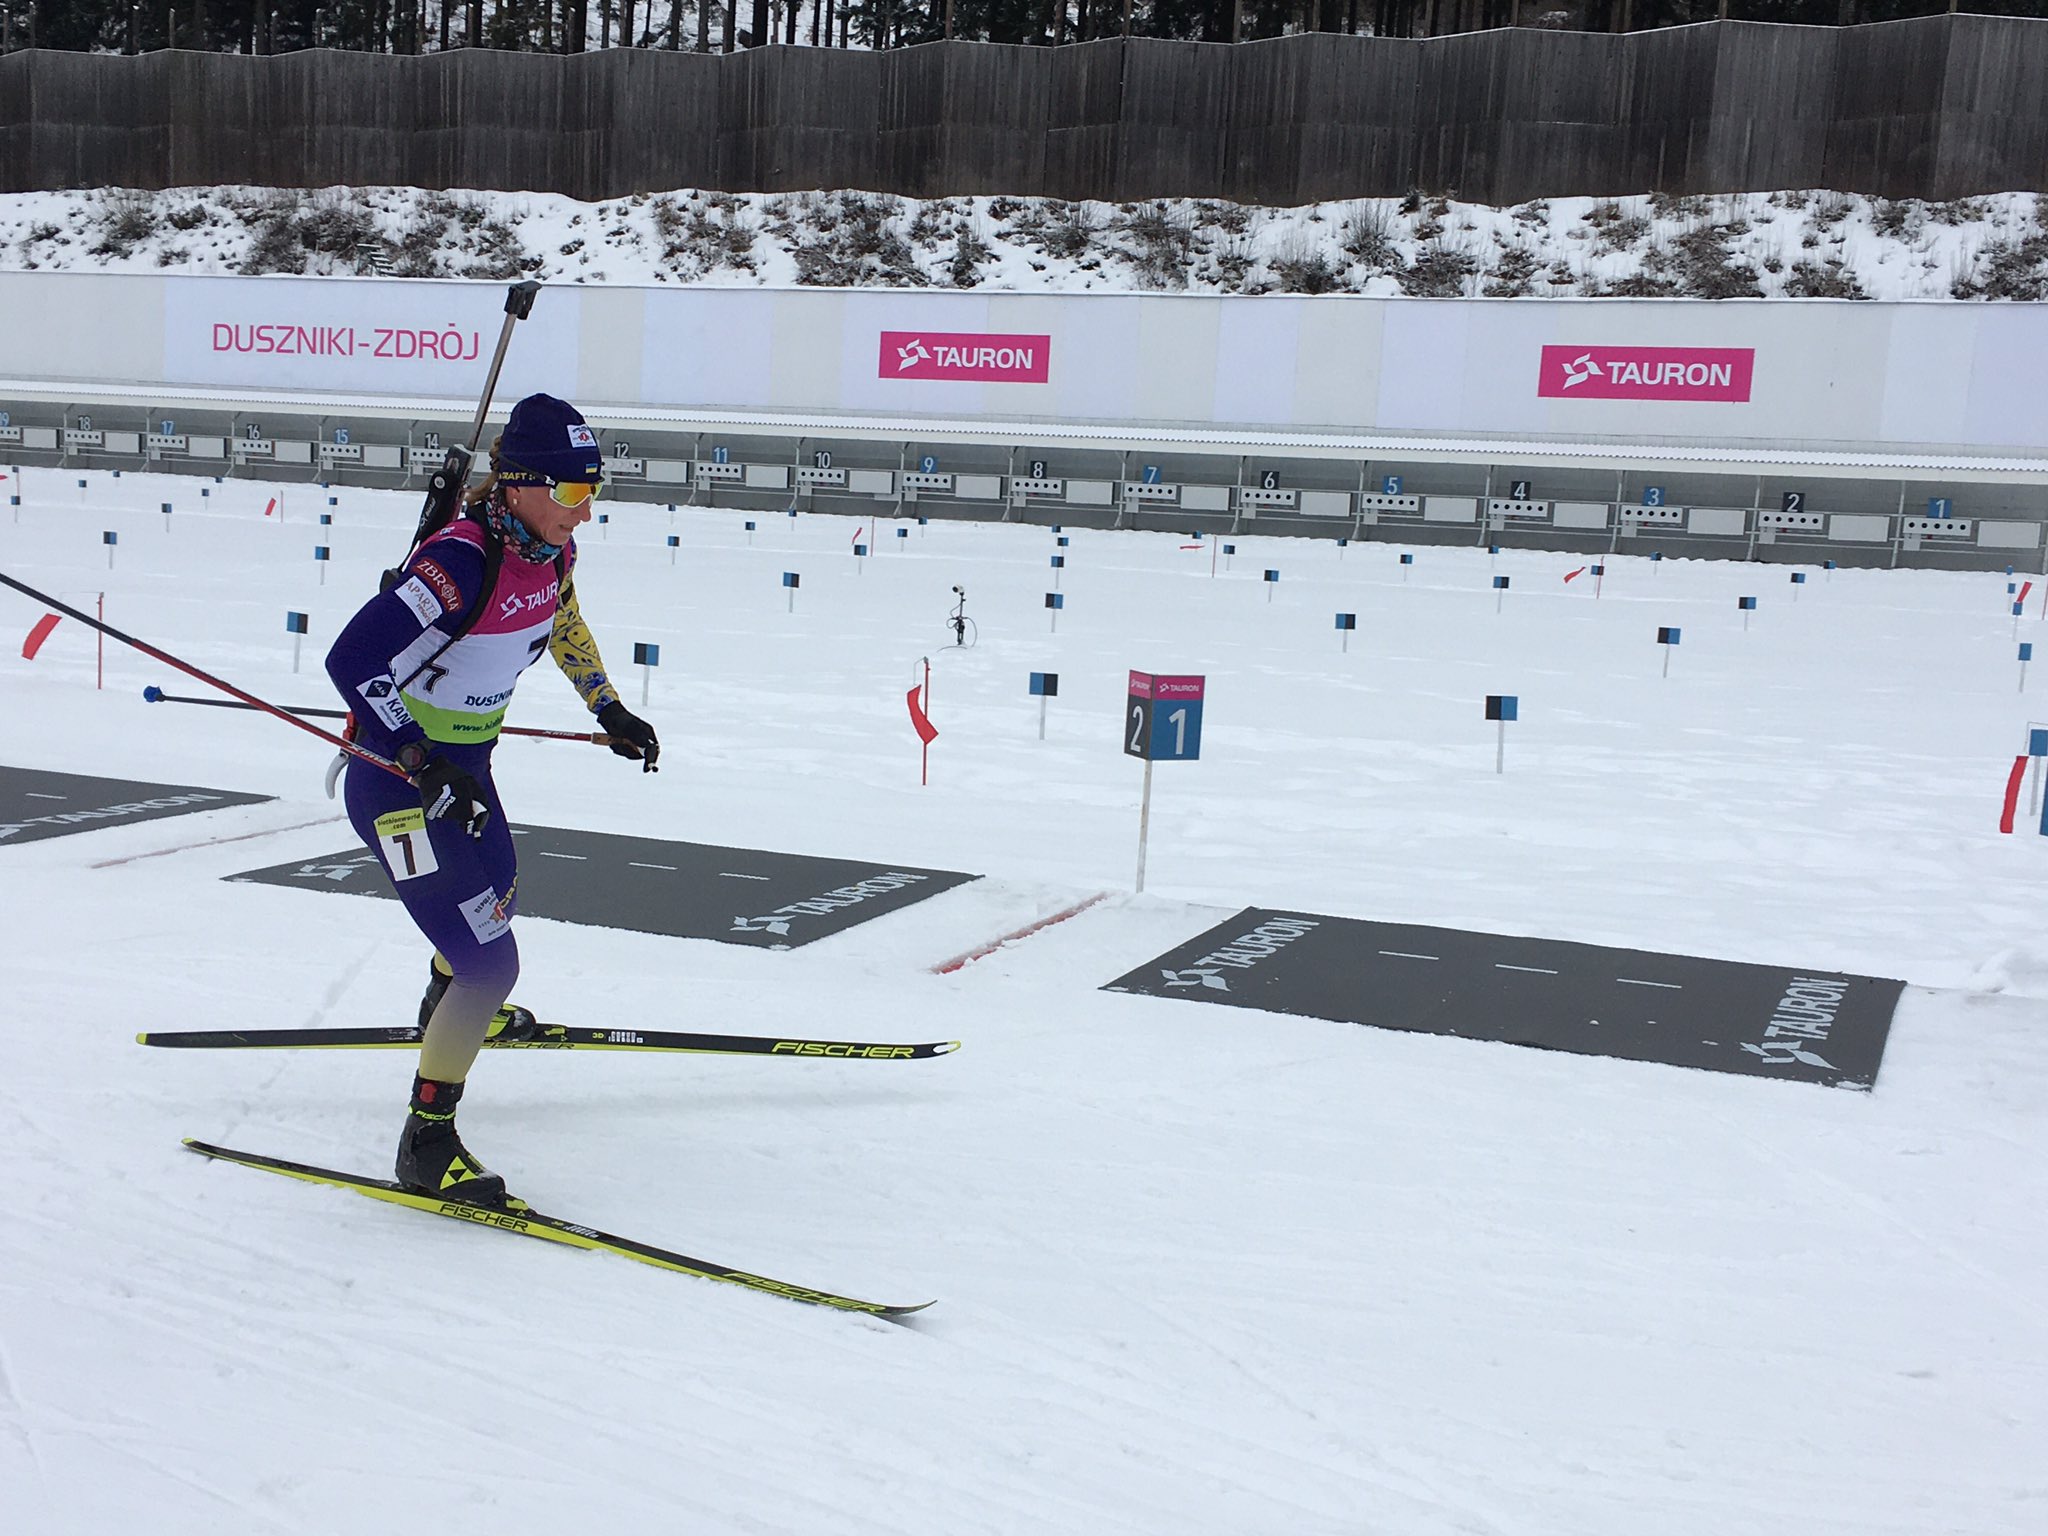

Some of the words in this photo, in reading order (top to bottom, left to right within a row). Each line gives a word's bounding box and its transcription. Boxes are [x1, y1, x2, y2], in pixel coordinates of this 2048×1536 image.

[932, 346, 1033, 369] TAURON
[1606, 361, 1732, 386] TAURON
[0, 412, 9, 427] 9
[79, 416, 91, 431] 18
[162, 420, 175, 435] 17
[247, 425, 260, 439] 16
[335, 429, 348, 444] 15
[425, 433, 439, 449] 14
[615, 443, 629, 458] 12
[714, 447, 728, 463] 11
[815, 452, 831, 468] 10
[924, 457, 934, 473] 9
[1033, 462, 1043, 478] 8
[1147, 467, 1158, 483] 7
[1264, 472, 1275, 489] 6
[1386, 477, 1398, 494] 5
[1513, 482, 1526, 500] 4
[1647, 488, 1659, 506] 3
[1788, 493, 1800, 512] 2
[1936, 499, 1946, 518] 1
[525, 579, 559, 611] TAUR
[421, 659, 449, 694] 7
[1170, 684, 1200, 692] TAURON
[386, 698, 411, 724] KAN
[1130, 705, 1143, 753] 2
[1168, 708, 1186, 755] 1
[23, 793, 225, 825] TAURON
[392, 833, 417, 876] 7
[773, 871, 929, 916] TAURON
[1193, 917, 1320, 968] TAURON
[1764, 976, 1849, 1040] TAURON
[772, 1041, 915, 1058] FISCHER
[439, 1203, 529, 1232] FISCHER
[722, 1272, 887, 1313] FISCHER
